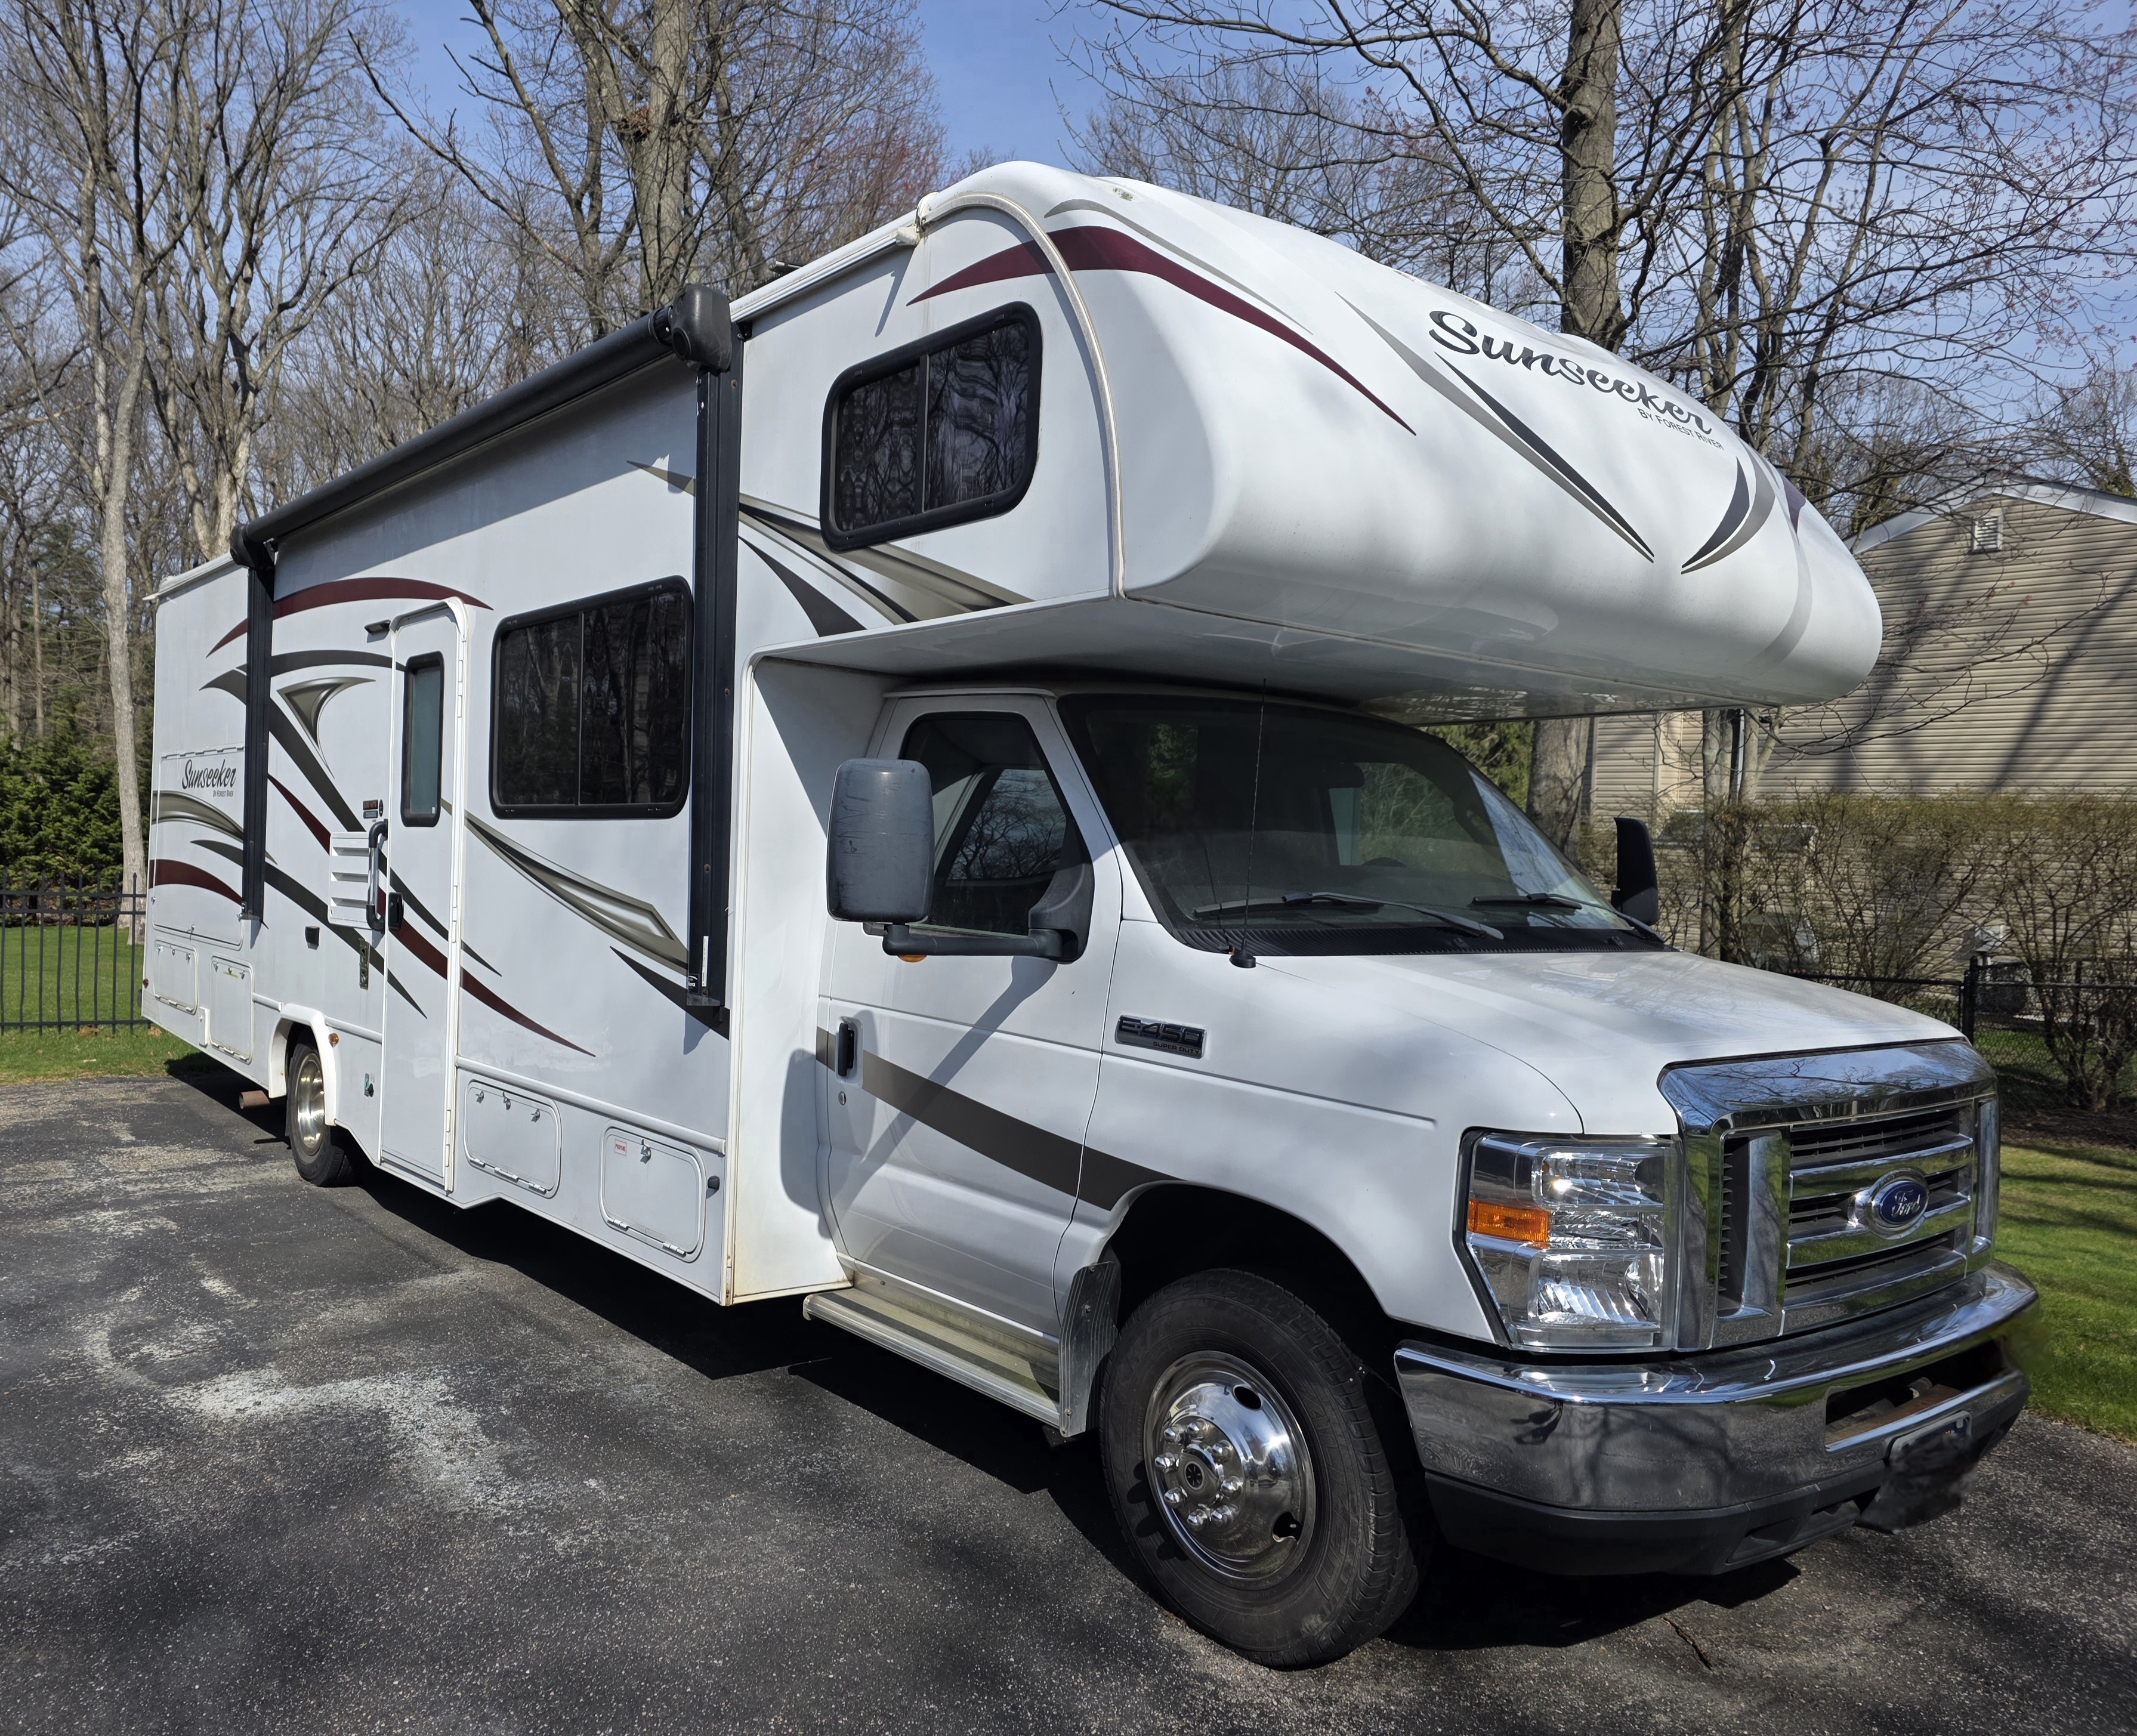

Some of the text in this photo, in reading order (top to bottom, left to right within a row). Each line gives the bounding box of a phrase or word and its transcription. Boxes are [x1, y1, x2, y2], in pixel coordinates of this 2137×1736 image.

[1429, 310, 1712, 435] Sunseeker
[1637, 407, 1725, 451] BY FOREST RIVER
[182, 759, 237, 789] Sunseeker
[1153, 1041, 1177, 1051] SUPER
[1891, 1189, 1920, 1218] Ford
